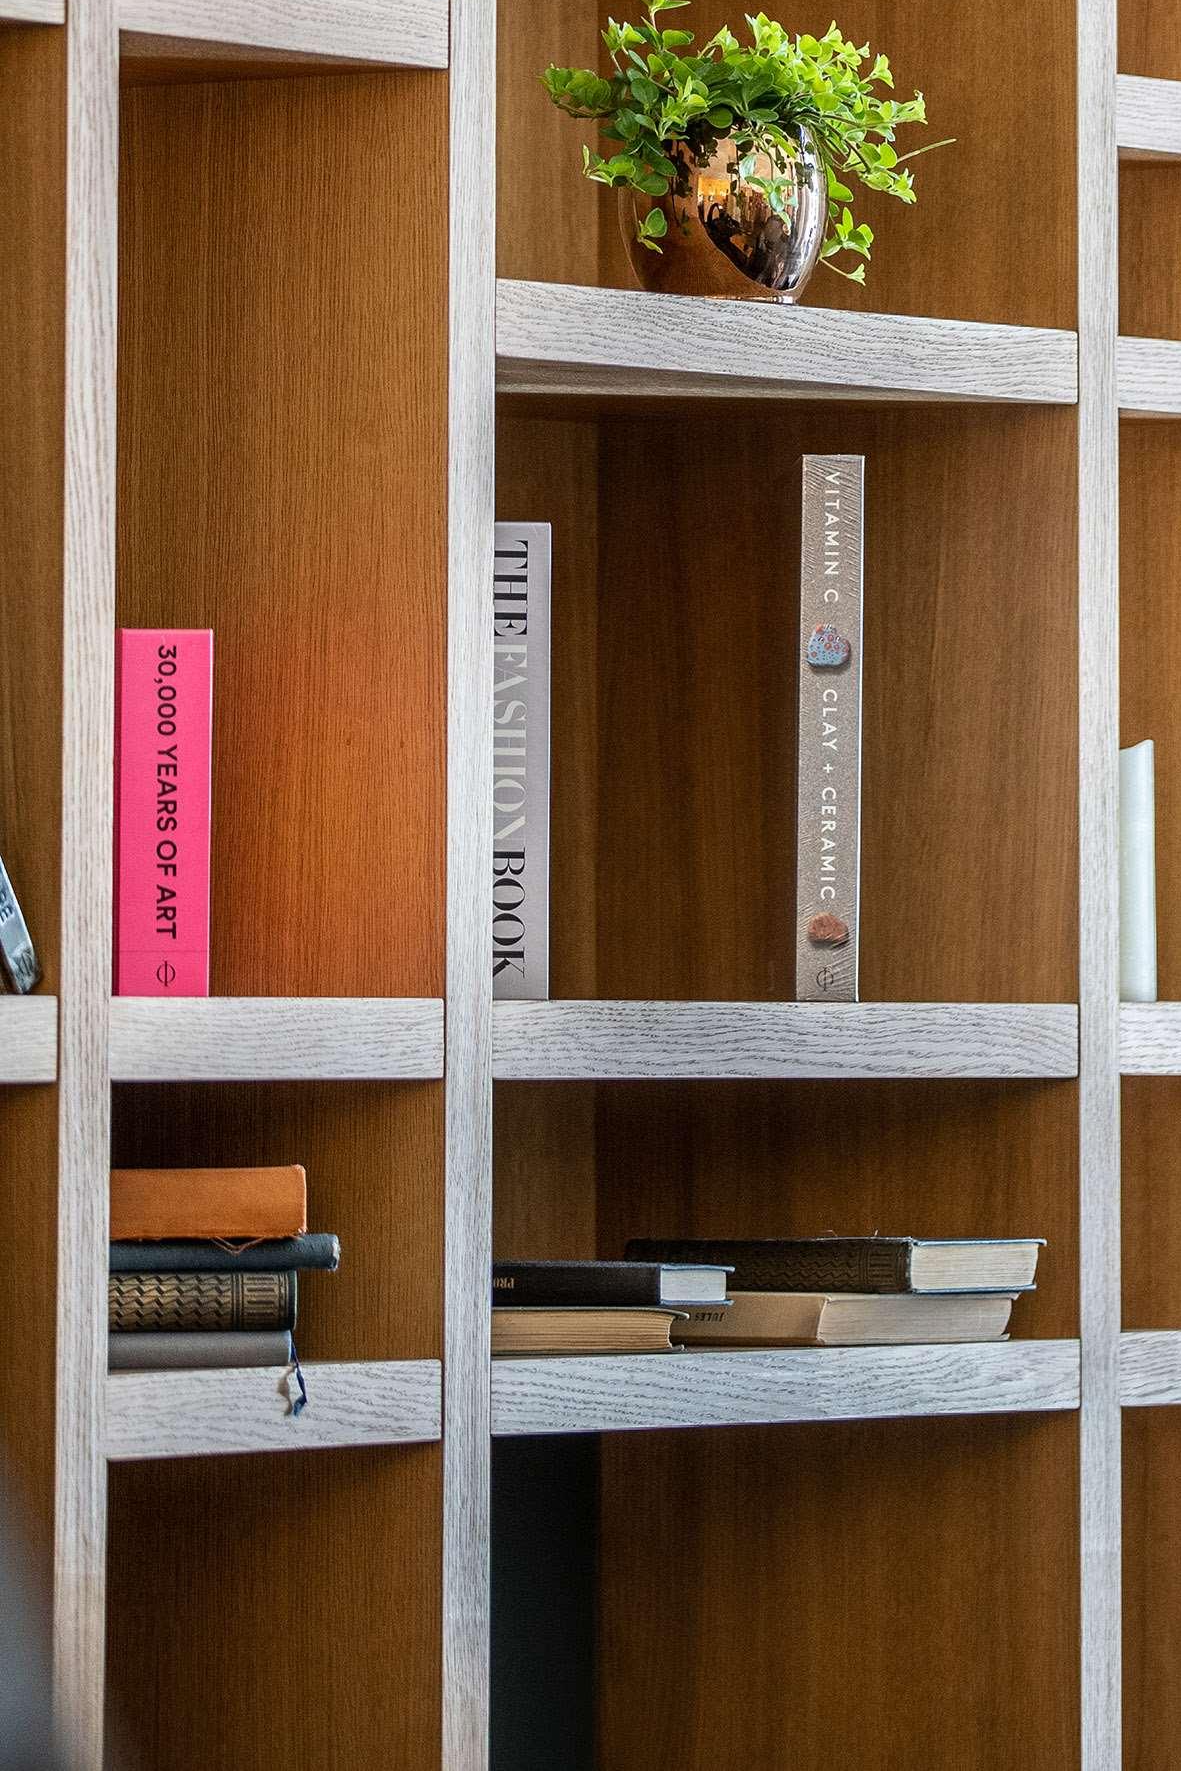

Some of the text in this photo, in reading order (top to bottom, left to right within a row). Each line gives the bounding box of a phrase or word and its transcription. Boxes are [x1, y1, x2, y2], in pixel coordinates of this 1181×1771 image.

[824, 471, 841, 604] VITAMIN C
[492, 539, 529, 979] THE FASHION BOOK
[822, 688, 838, 750] CLAY
[154, 644, 178, 940] 30,000 YEARS OF ART
[819, 786, 837, 901] CERAMIC
[695, 1312, 724, 1322] JULES
